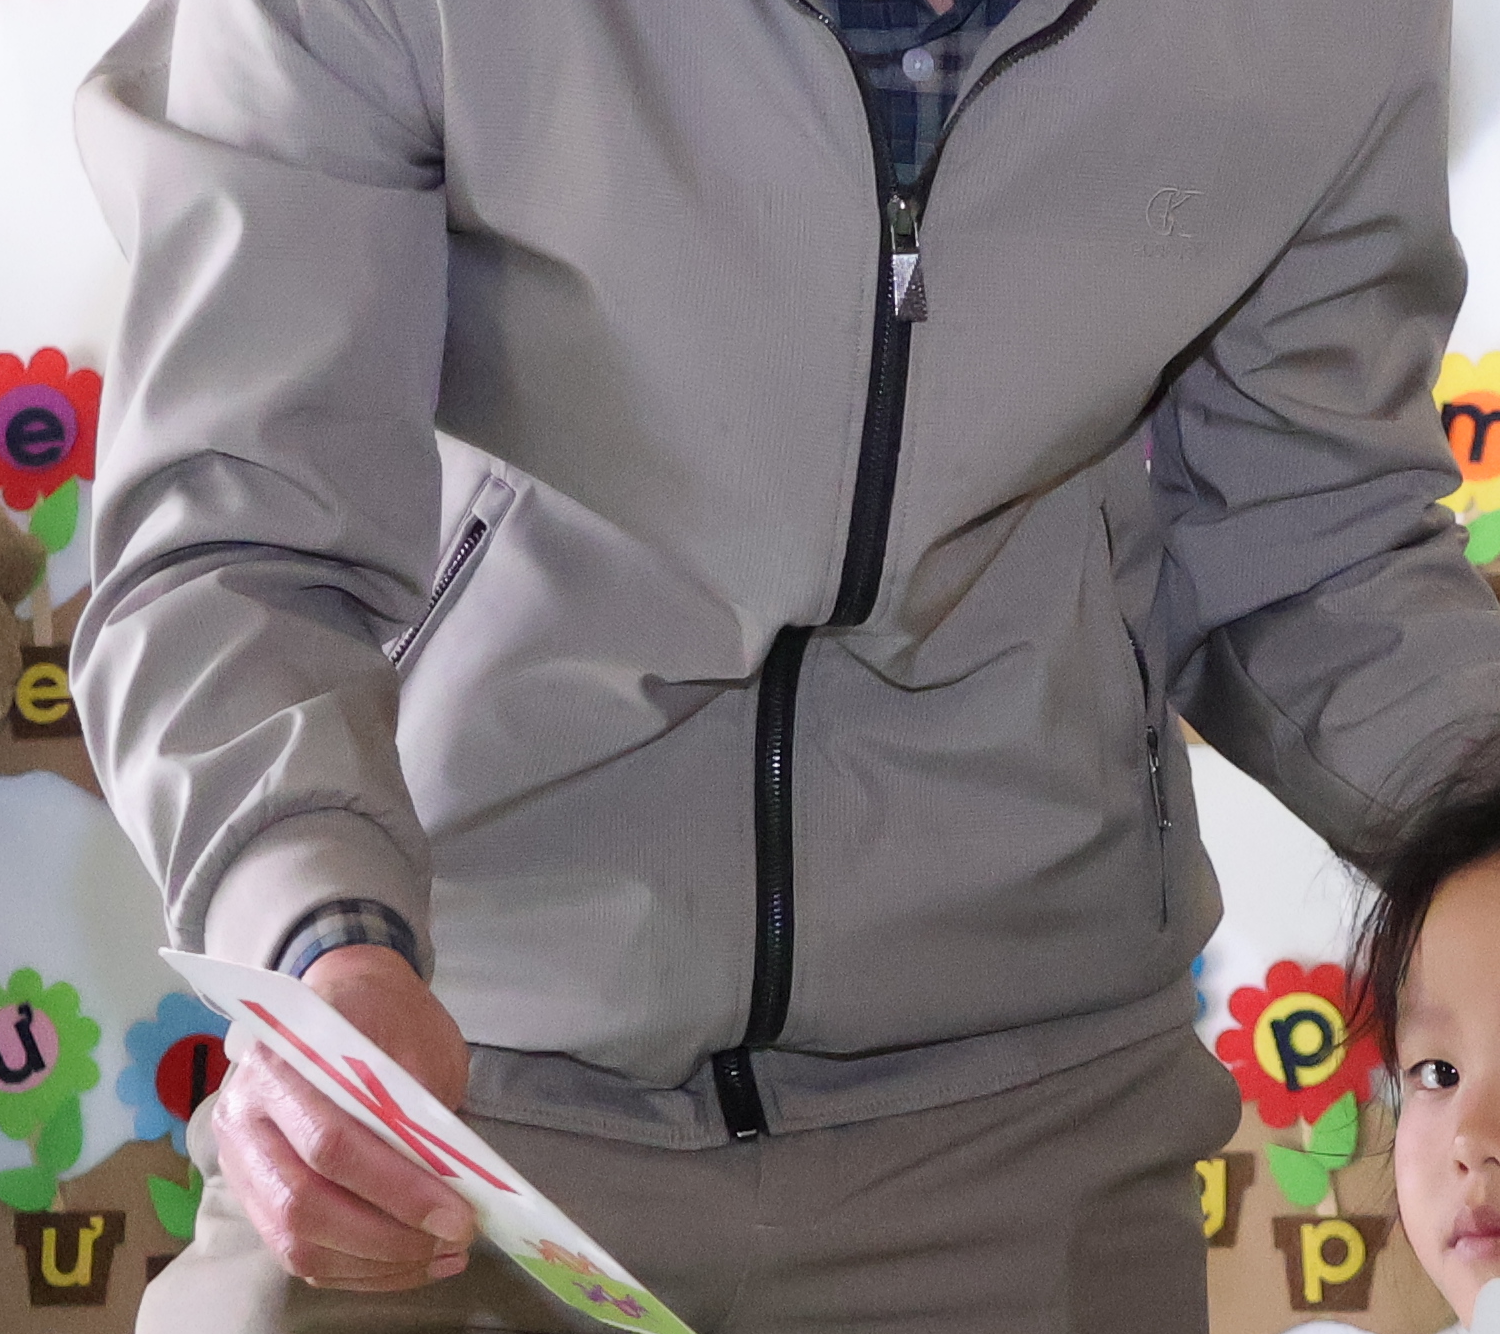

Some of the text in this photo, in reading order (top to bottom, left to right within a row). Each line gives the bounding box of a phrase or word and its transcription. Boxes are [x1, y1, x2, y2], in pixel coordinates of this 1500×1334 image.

[5, 407, 65, 467] e
[15, 661, 72, 724] e
[1270, 1010, 1338, 1091] p
[41, 1216, 105, 1286] ư
[1301, 1220, 1366, 1303] p
